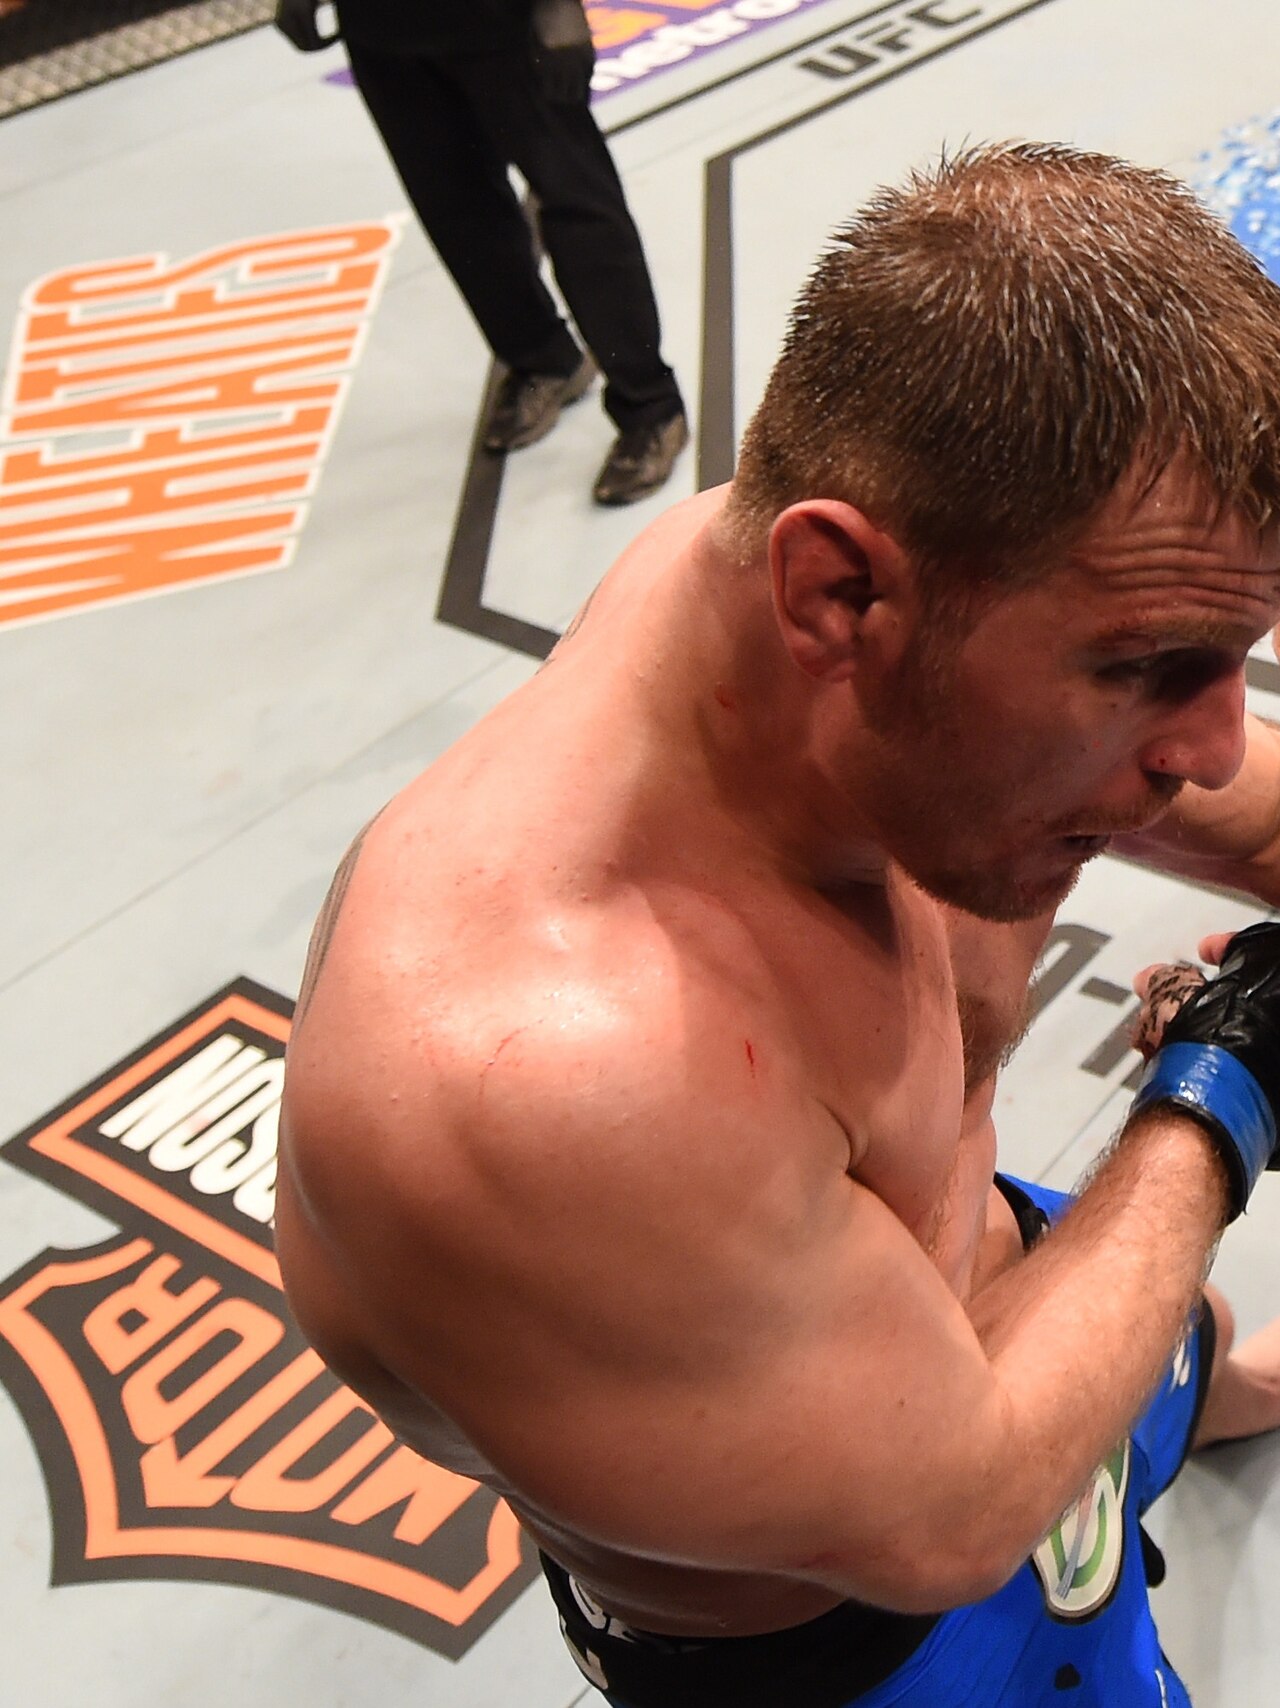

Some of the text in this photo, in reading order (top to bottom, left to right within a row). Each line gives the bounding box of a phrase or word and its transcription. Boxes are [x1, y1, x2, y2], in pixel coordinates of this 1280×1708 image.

[797, 0, 984, 80] UFC
[0, 218, 402, 630] WHEATIES
[82, 1254, 483, 1546] MOTOR
